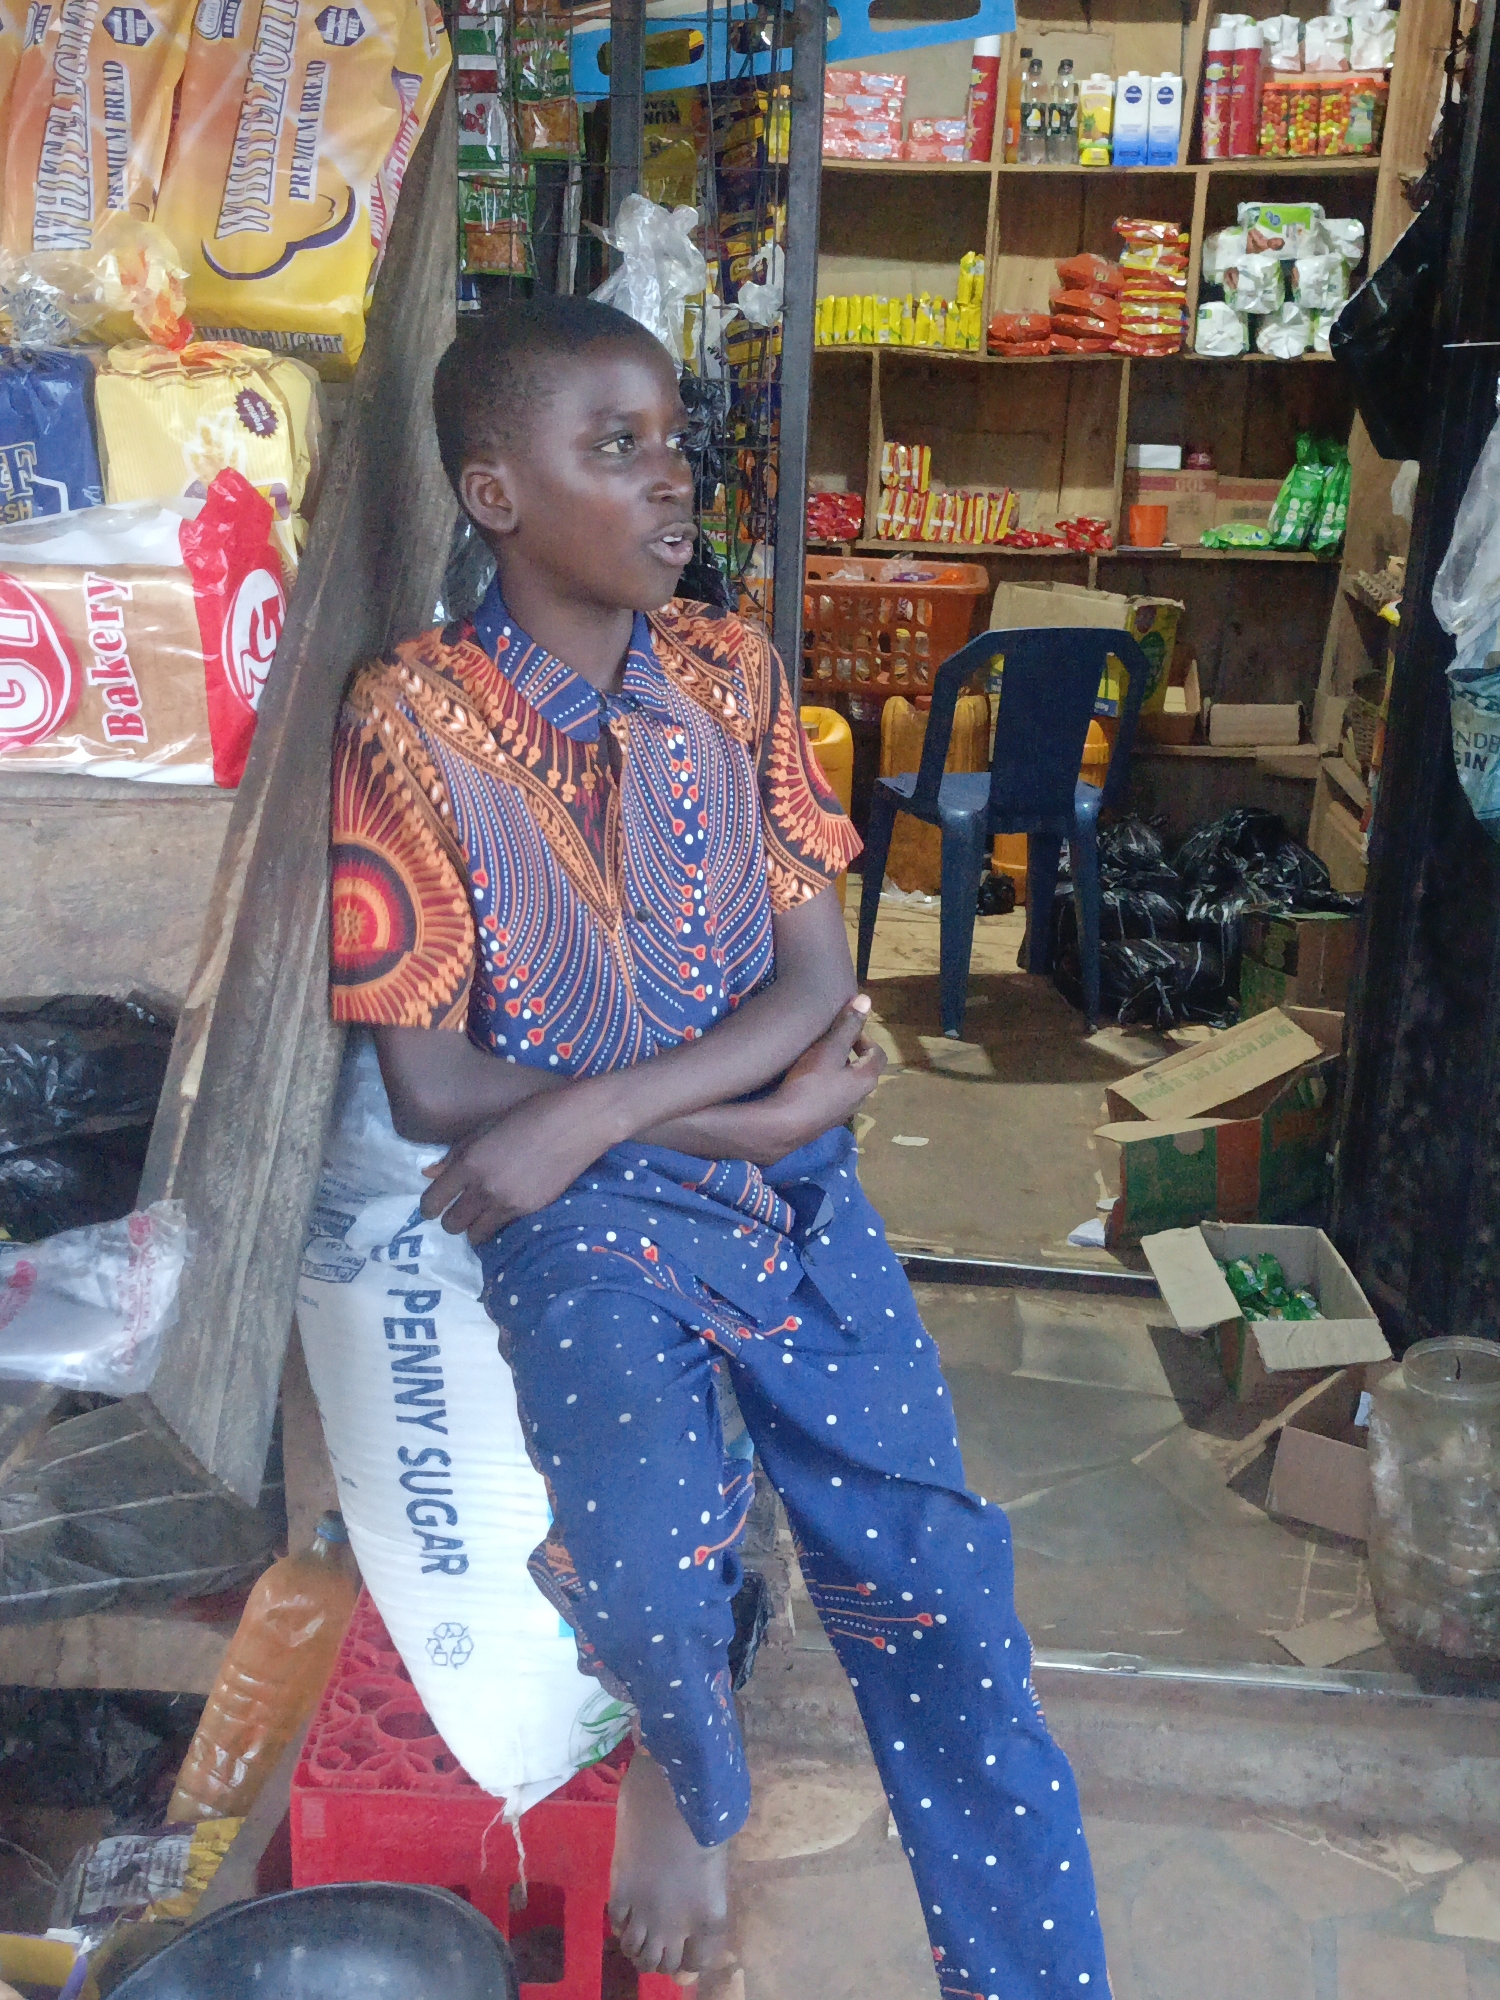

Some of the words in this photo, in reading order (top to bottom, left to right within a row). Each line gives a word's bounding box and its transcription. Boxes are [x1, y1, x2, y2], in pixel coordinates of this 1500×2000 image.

[346, 16, 361, 39] FREE
[102, 60, 126, 122] BREAD
[300, 59, 327, 113] BREAD
[288, 117, 320, 201] PREMIUM
[84, 572, 148, 742] Bakery
[384, 1288, 449, 1435] PENNY
[396, 1446, 470, 1577] SUGAR
